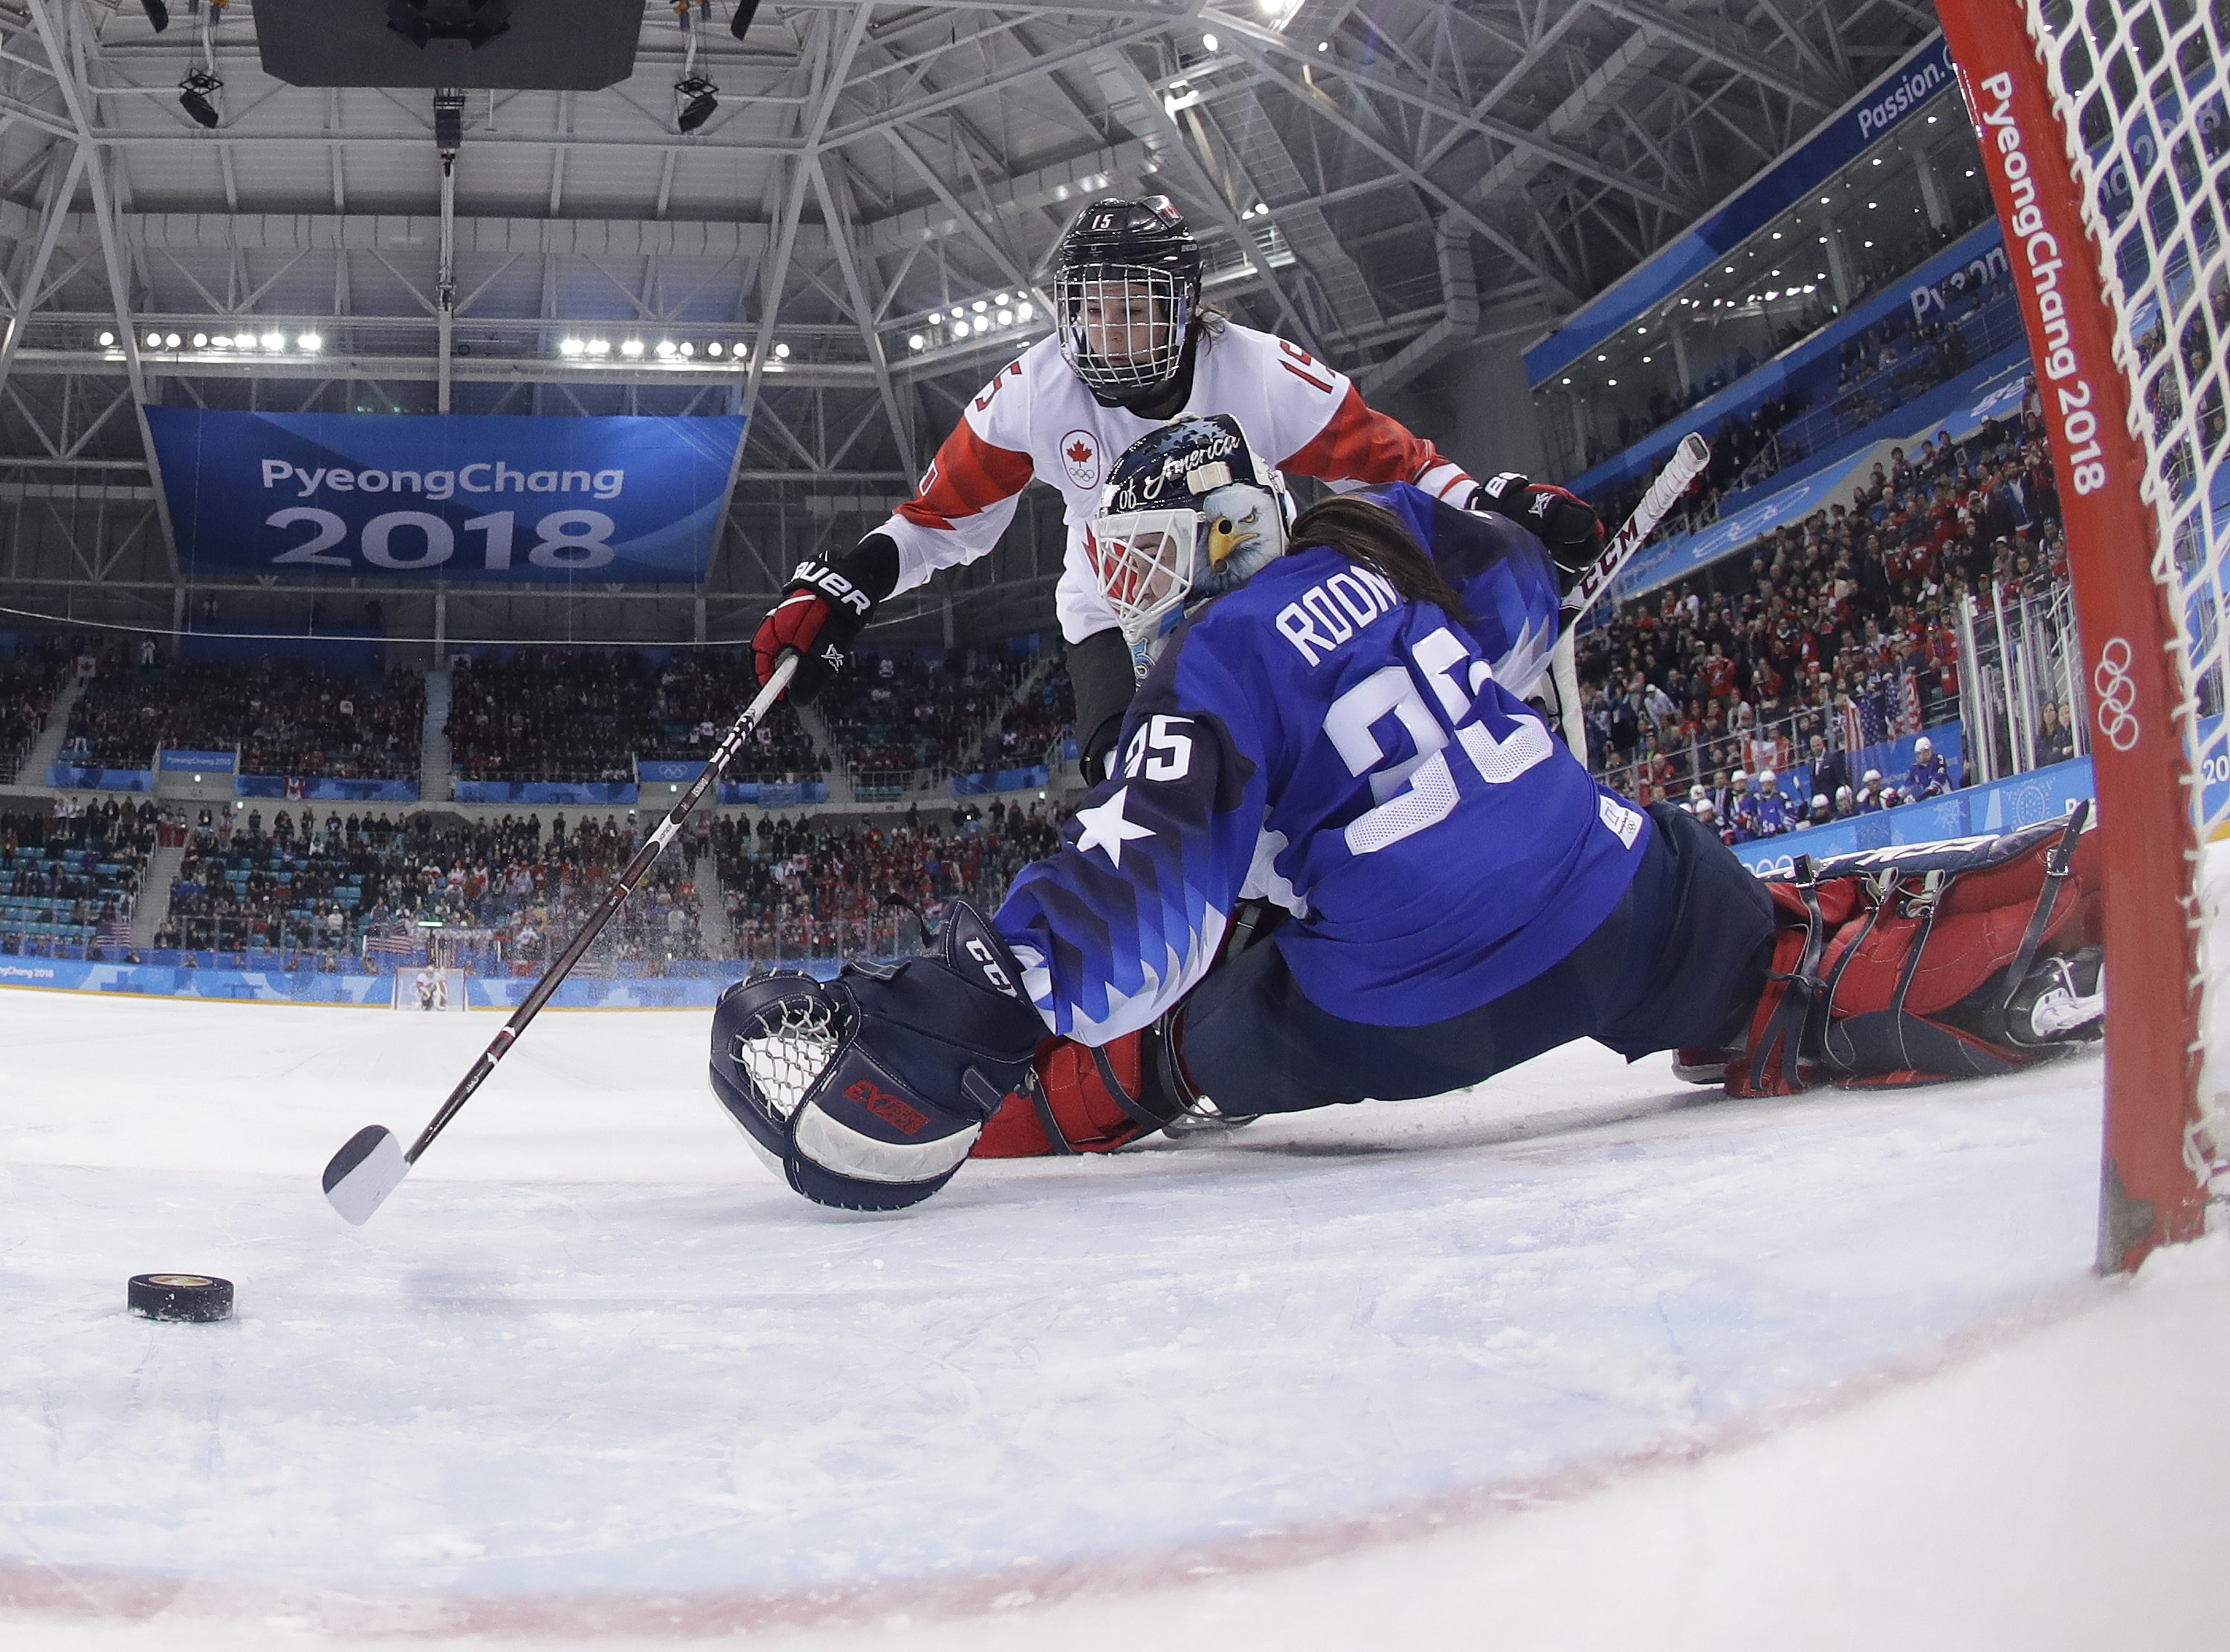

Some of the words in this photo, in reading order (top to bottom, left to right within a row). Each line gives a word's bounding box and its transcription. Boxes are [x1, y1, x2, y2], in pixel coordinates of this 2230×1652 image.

[1858, 62, 1945, 140] Passion.
[1091, 214, 1114, 230] 15
[1980, 71, 2076, 381] PyeongChang
[2057, 380, 2106, 496] 2018
[262, 459, 625, 500] PyeongChang
[265, 507, 616, 570] 2018
[1579, 515, 1638, 600] CCM
